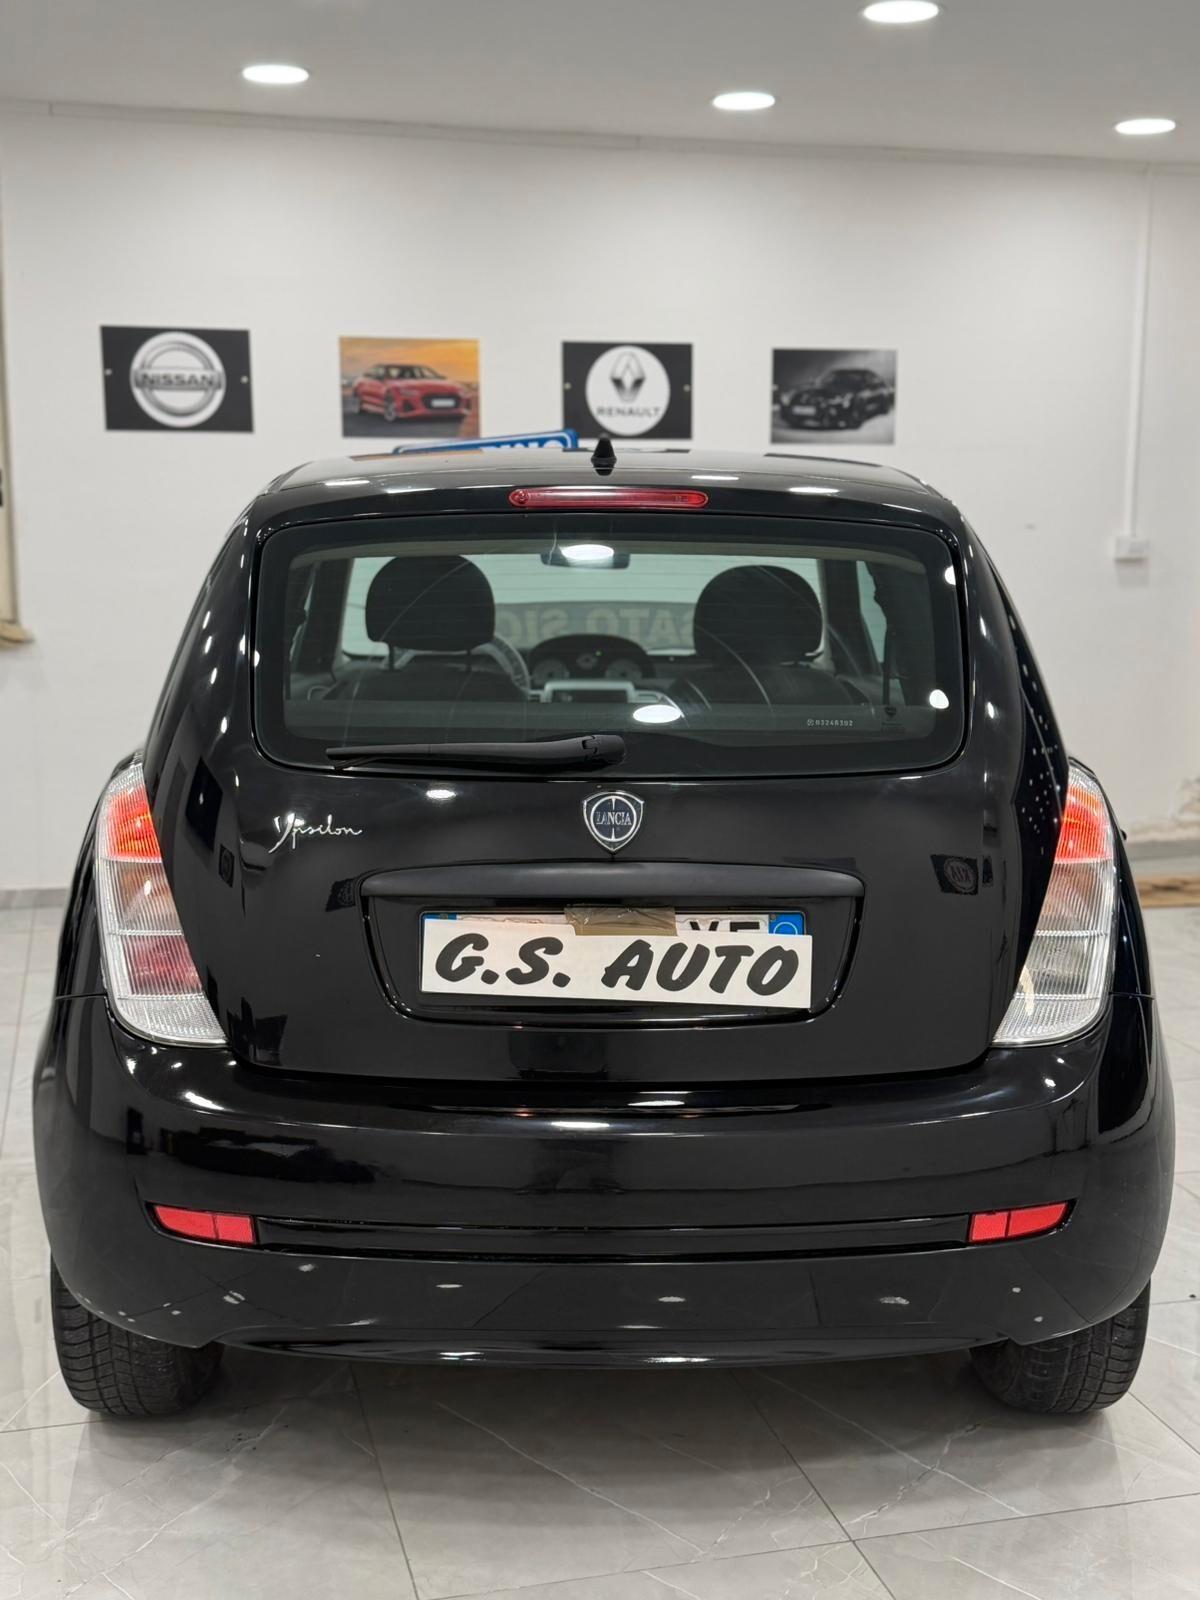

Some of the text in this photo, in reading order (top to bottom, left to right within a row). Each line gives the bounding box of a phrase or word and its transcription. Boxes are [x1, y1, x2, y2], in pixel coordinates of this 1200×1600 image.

[141, 372, 214, 387] NISSAN
[597, 406, 661, 417] RENAULT
[594, 811, 632, 826] LANCIA
[268, 813, 363, 853] Ypsilon
[435, 933, 799, 996] G.S. AUTO
